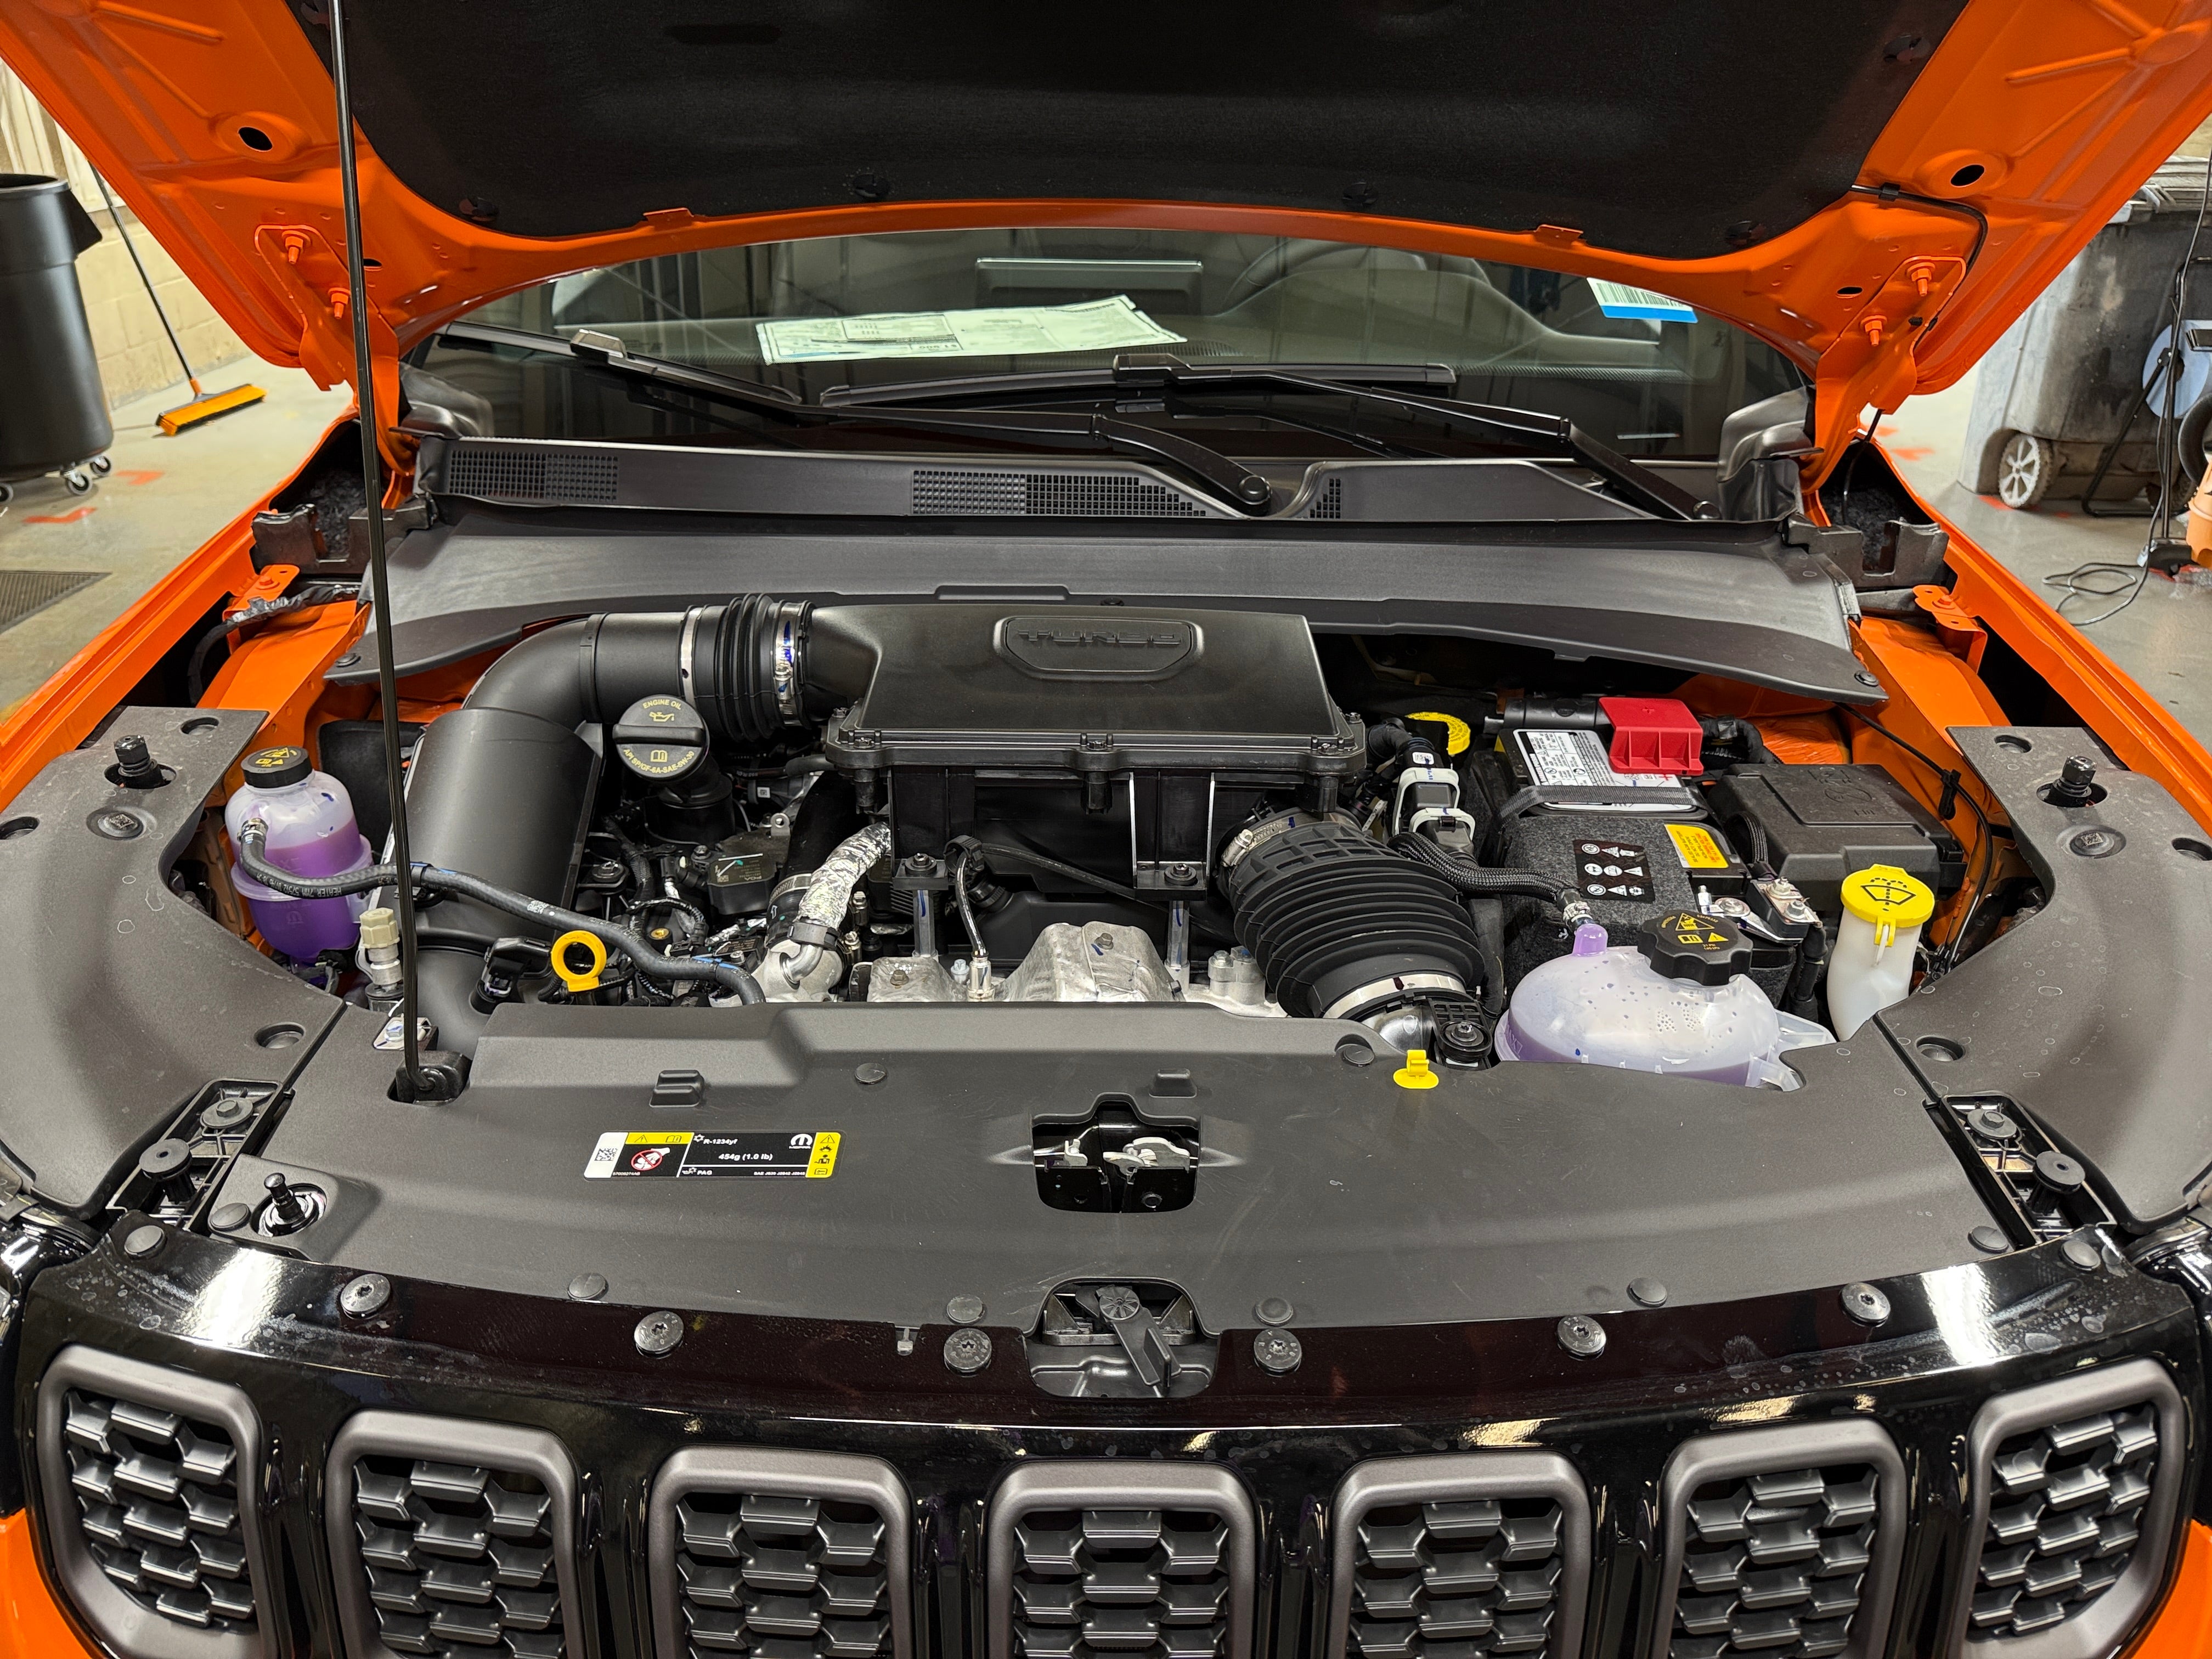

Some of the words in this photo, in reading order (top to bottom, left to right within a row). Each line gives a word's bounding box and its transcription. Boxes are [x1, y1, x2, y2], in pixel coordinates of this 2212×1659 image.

[642, 699, 670, 709] ENGINE
[670, 700, 681, 710] OIL
[623, 748, 634, 760] API
[317, 887, 342, 896] HEATER
